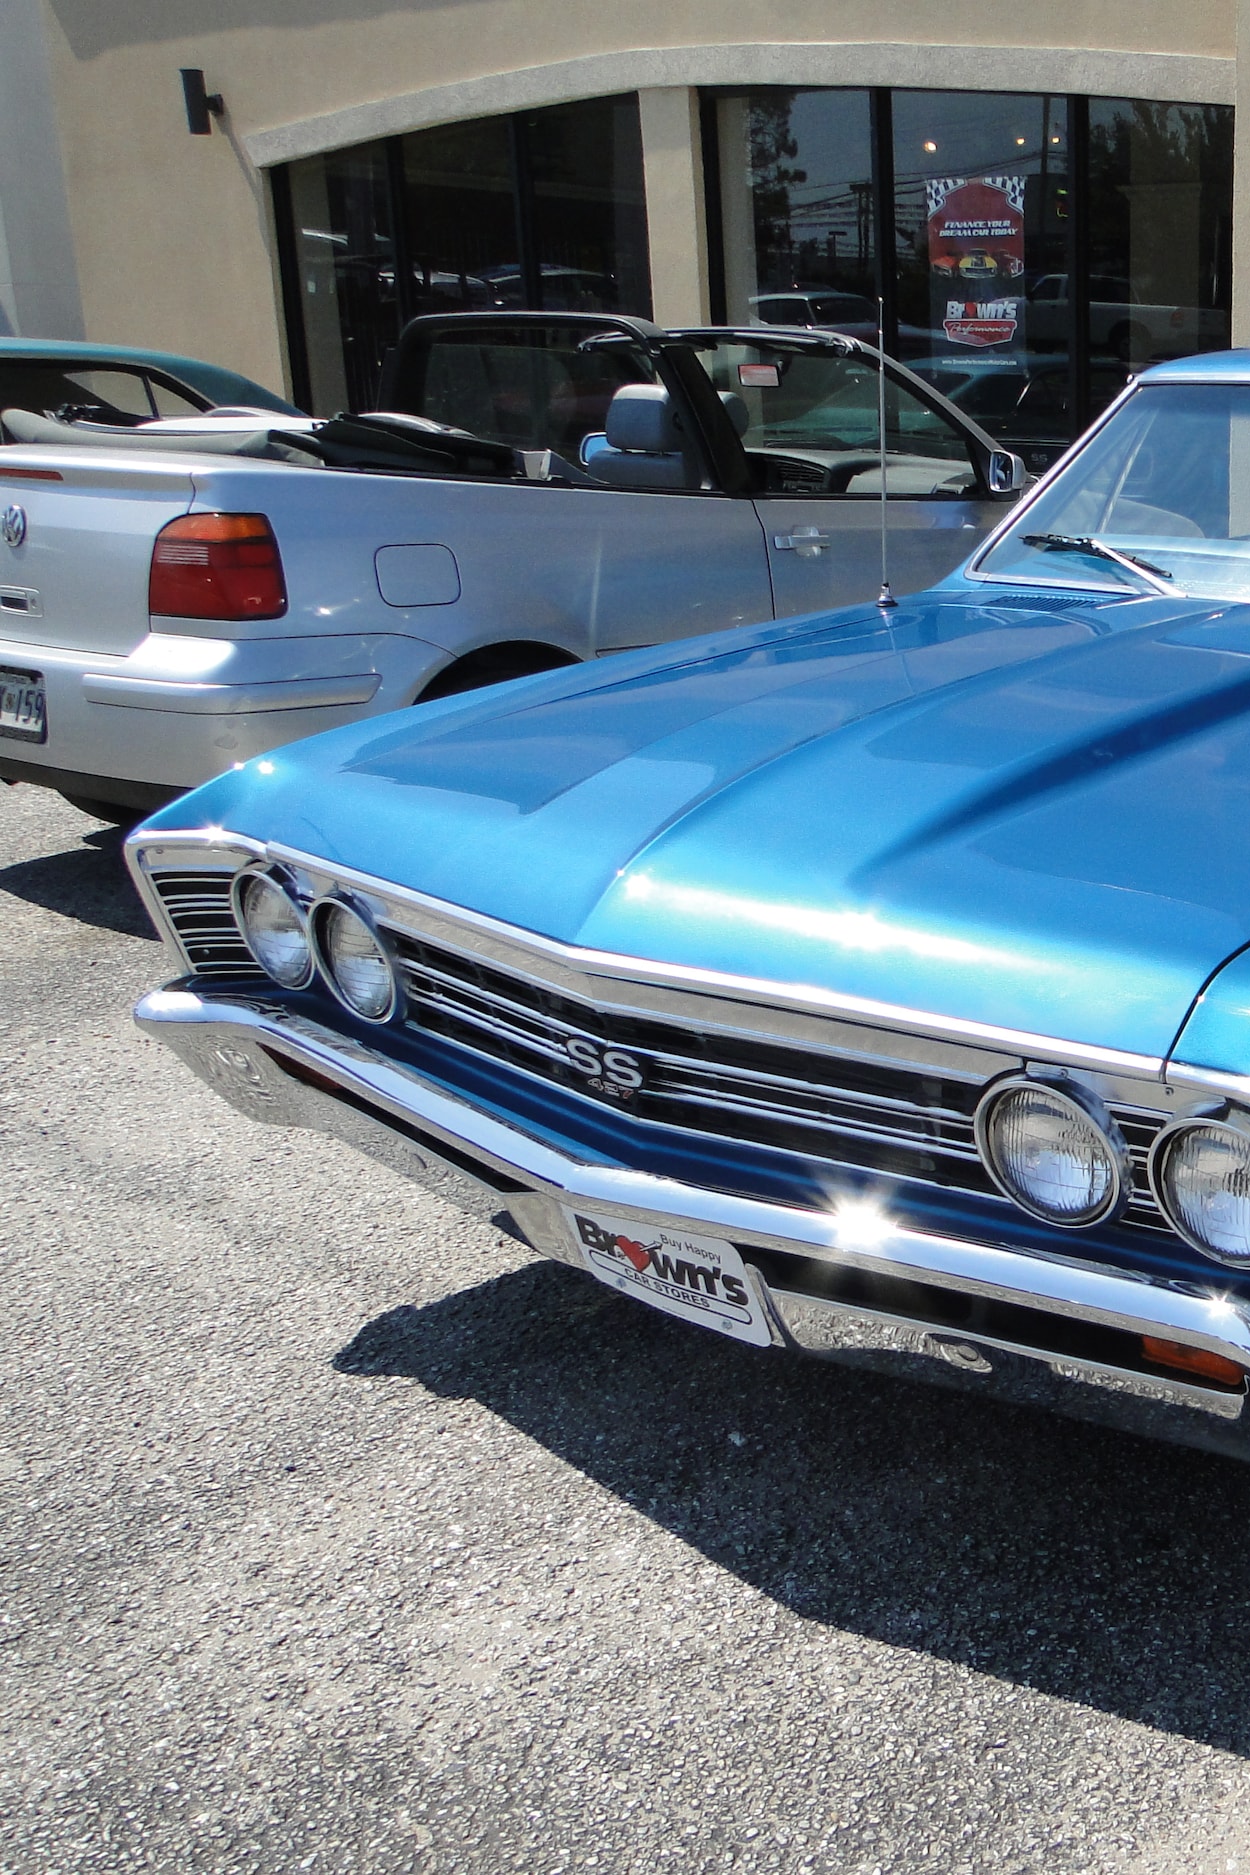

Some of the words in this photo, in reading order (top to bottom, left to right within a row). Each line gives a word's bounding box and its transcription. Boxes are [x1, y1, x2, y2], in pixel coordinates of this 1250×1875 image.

[939, 229, 972, 237] DREAM
[972, 229, 990, 237] CAR
[991, 228, 1018, 236] TODAY
[944, 221, 986, 229] FINANCE
[987, 220, 1011, 228] YOUR
[949, 322, 1011, 335] Performance
[566, 1038, 643, 1087] SS
[660, 1233, 683, 1250] Buy
[684, 1241, 722, 1264] Happy
[624, 1268, 650, 1286] CAR
[653, 1279, 711, 1308] STORES
